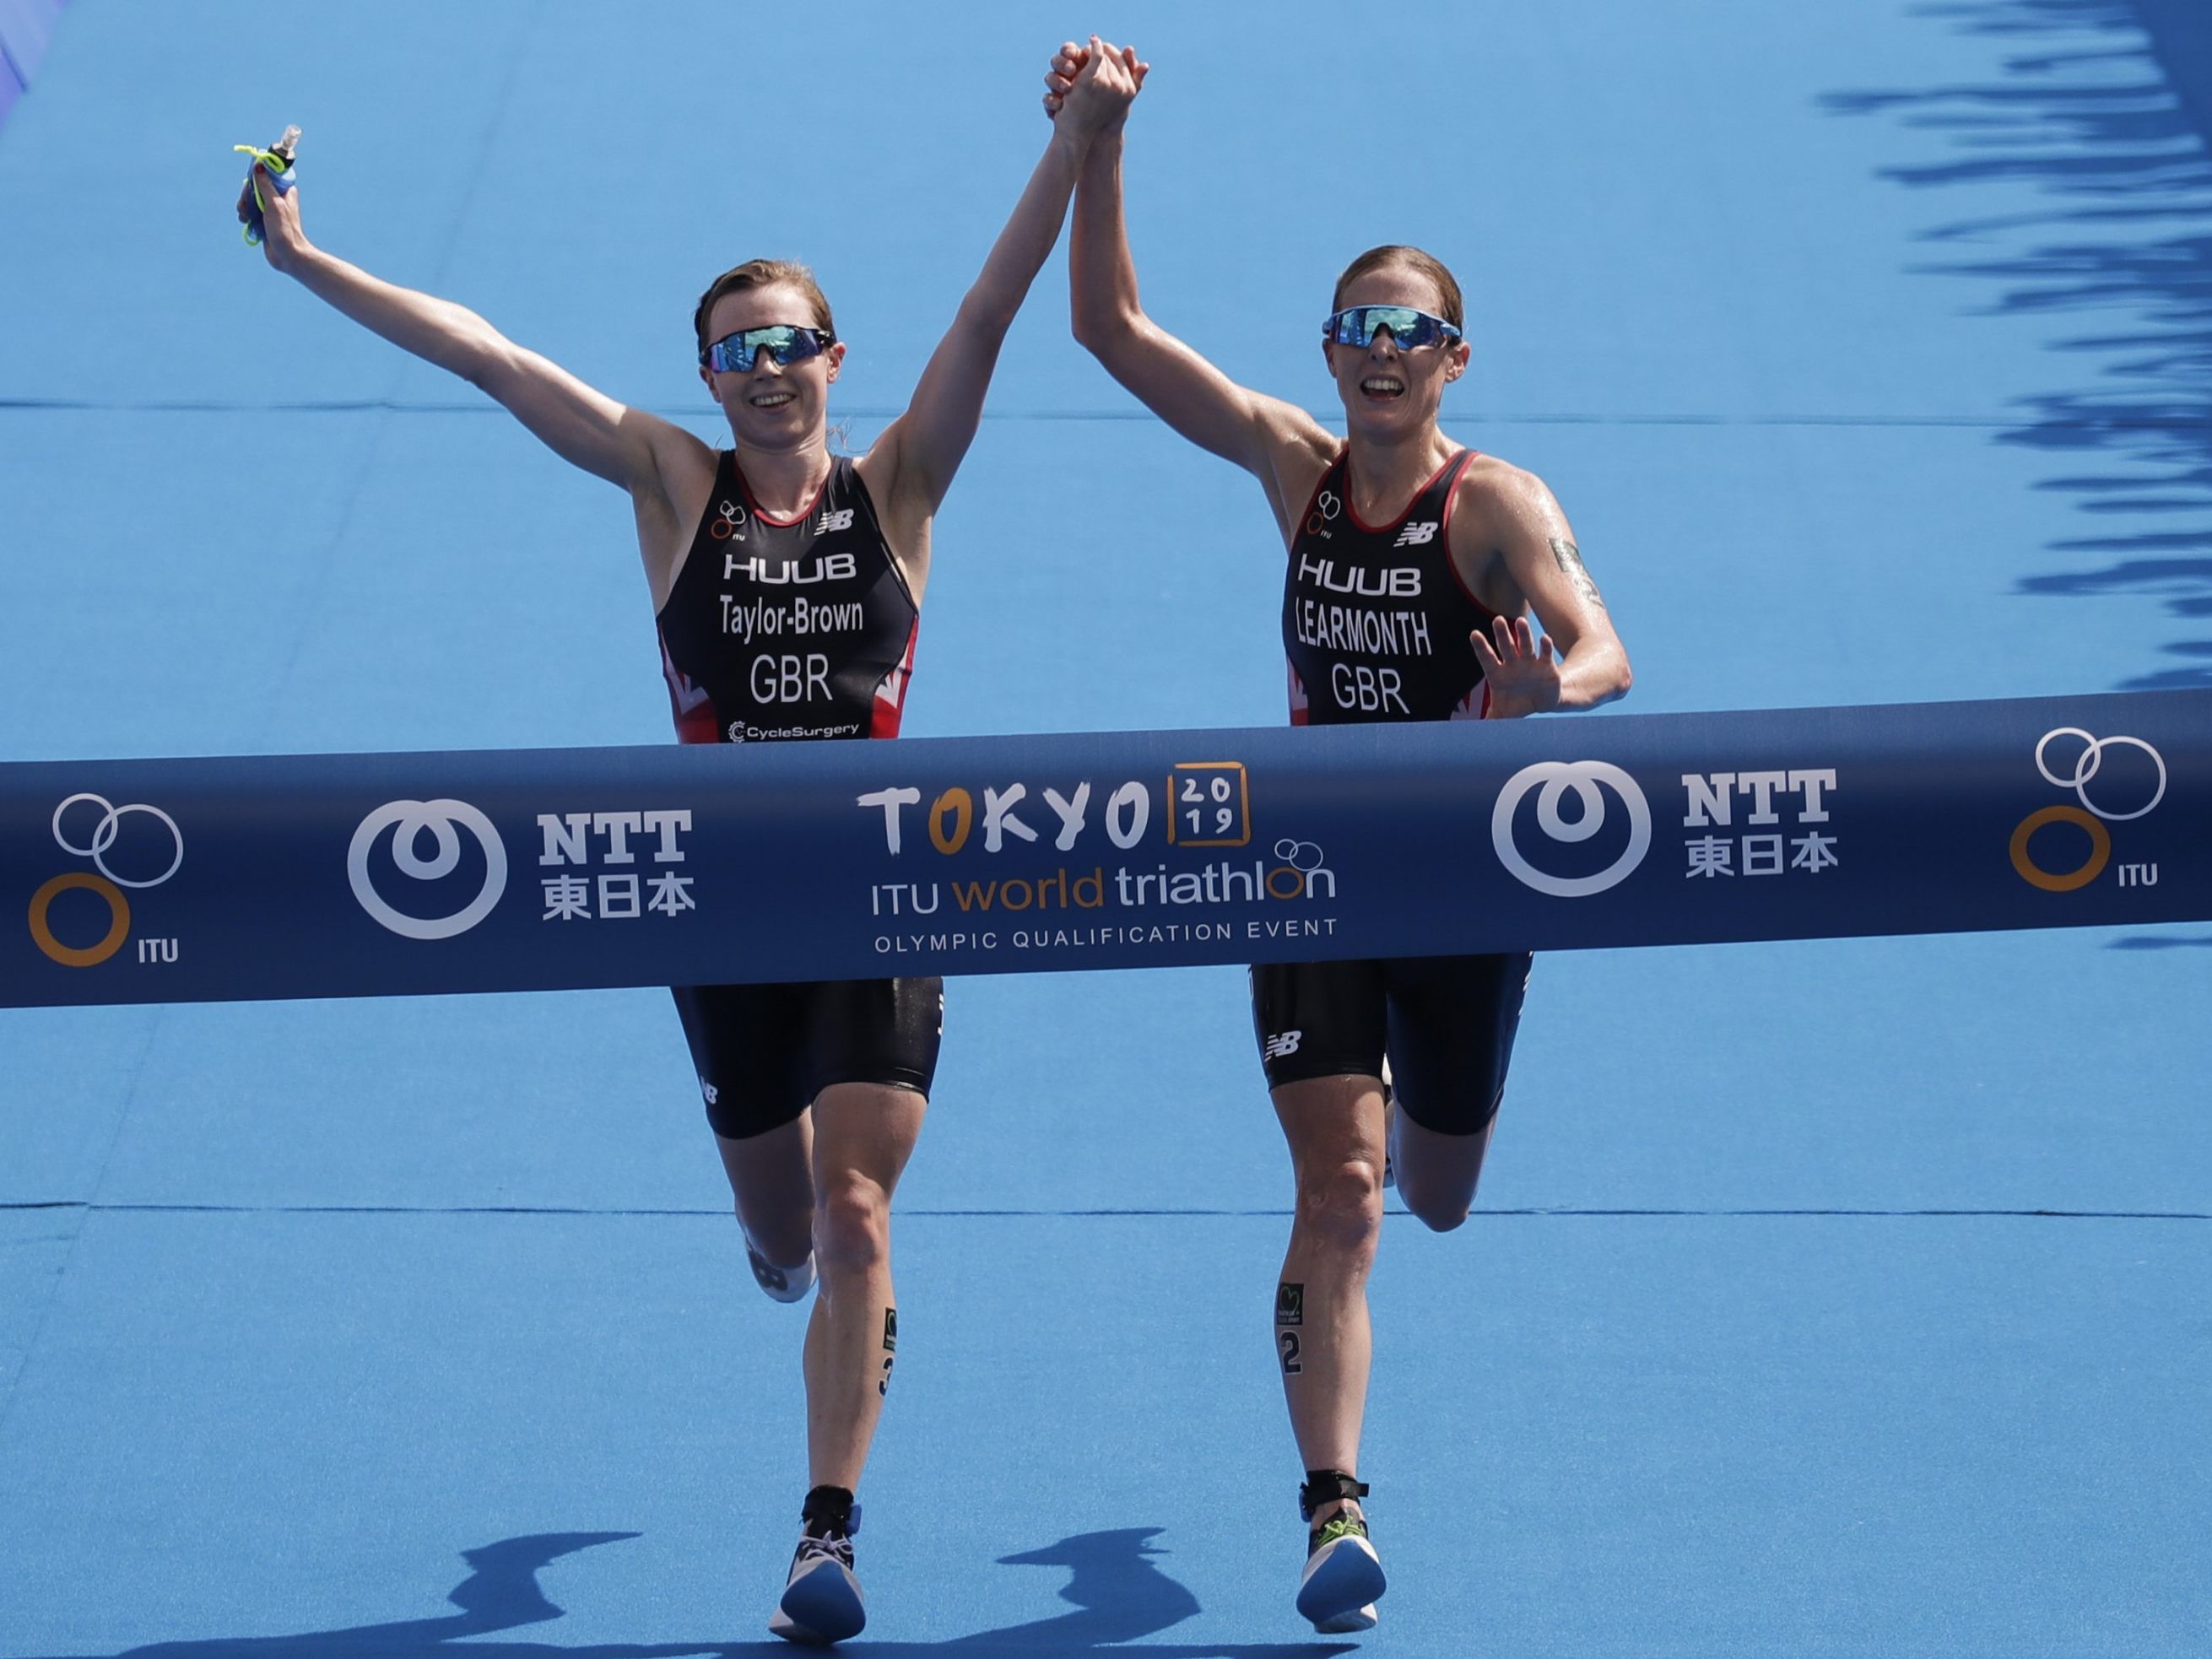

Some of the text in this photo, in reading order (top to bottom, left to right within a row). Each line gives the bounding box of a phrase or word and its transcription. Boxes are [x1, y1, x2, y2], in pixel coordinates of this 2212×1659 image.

[723, 553, 857, 585] HUUB
[1296, 553, 1422, 597] HUUB
[720, 595, 863, 644] Taylor-Brown
[1295, 596, 1432, 656] LEARMONTH
[751, 654, 832, 703] GBR
[1333, 663, 1409, 713] GBR
[747, 723, 860, 740] CycleSurgery
[856, 780, 1151, 857] TOKYO
[1682, 769, 1836, 826] NTT
[538, 810, 691, 865] NTT
[1685, 831, 1837, 878] 東日本
[541, 872, 695, 920] 東日本
[873, 856, 1337, 915] ITU world triathlon
[2118, 862, 2159, 888] ITU
[139, 938, 178, 963] ITU
[875, 919, 1336, 952] OLYMPIC QUALIFICATION EVENT
[1280, 1330, 1303, 1374] 2
